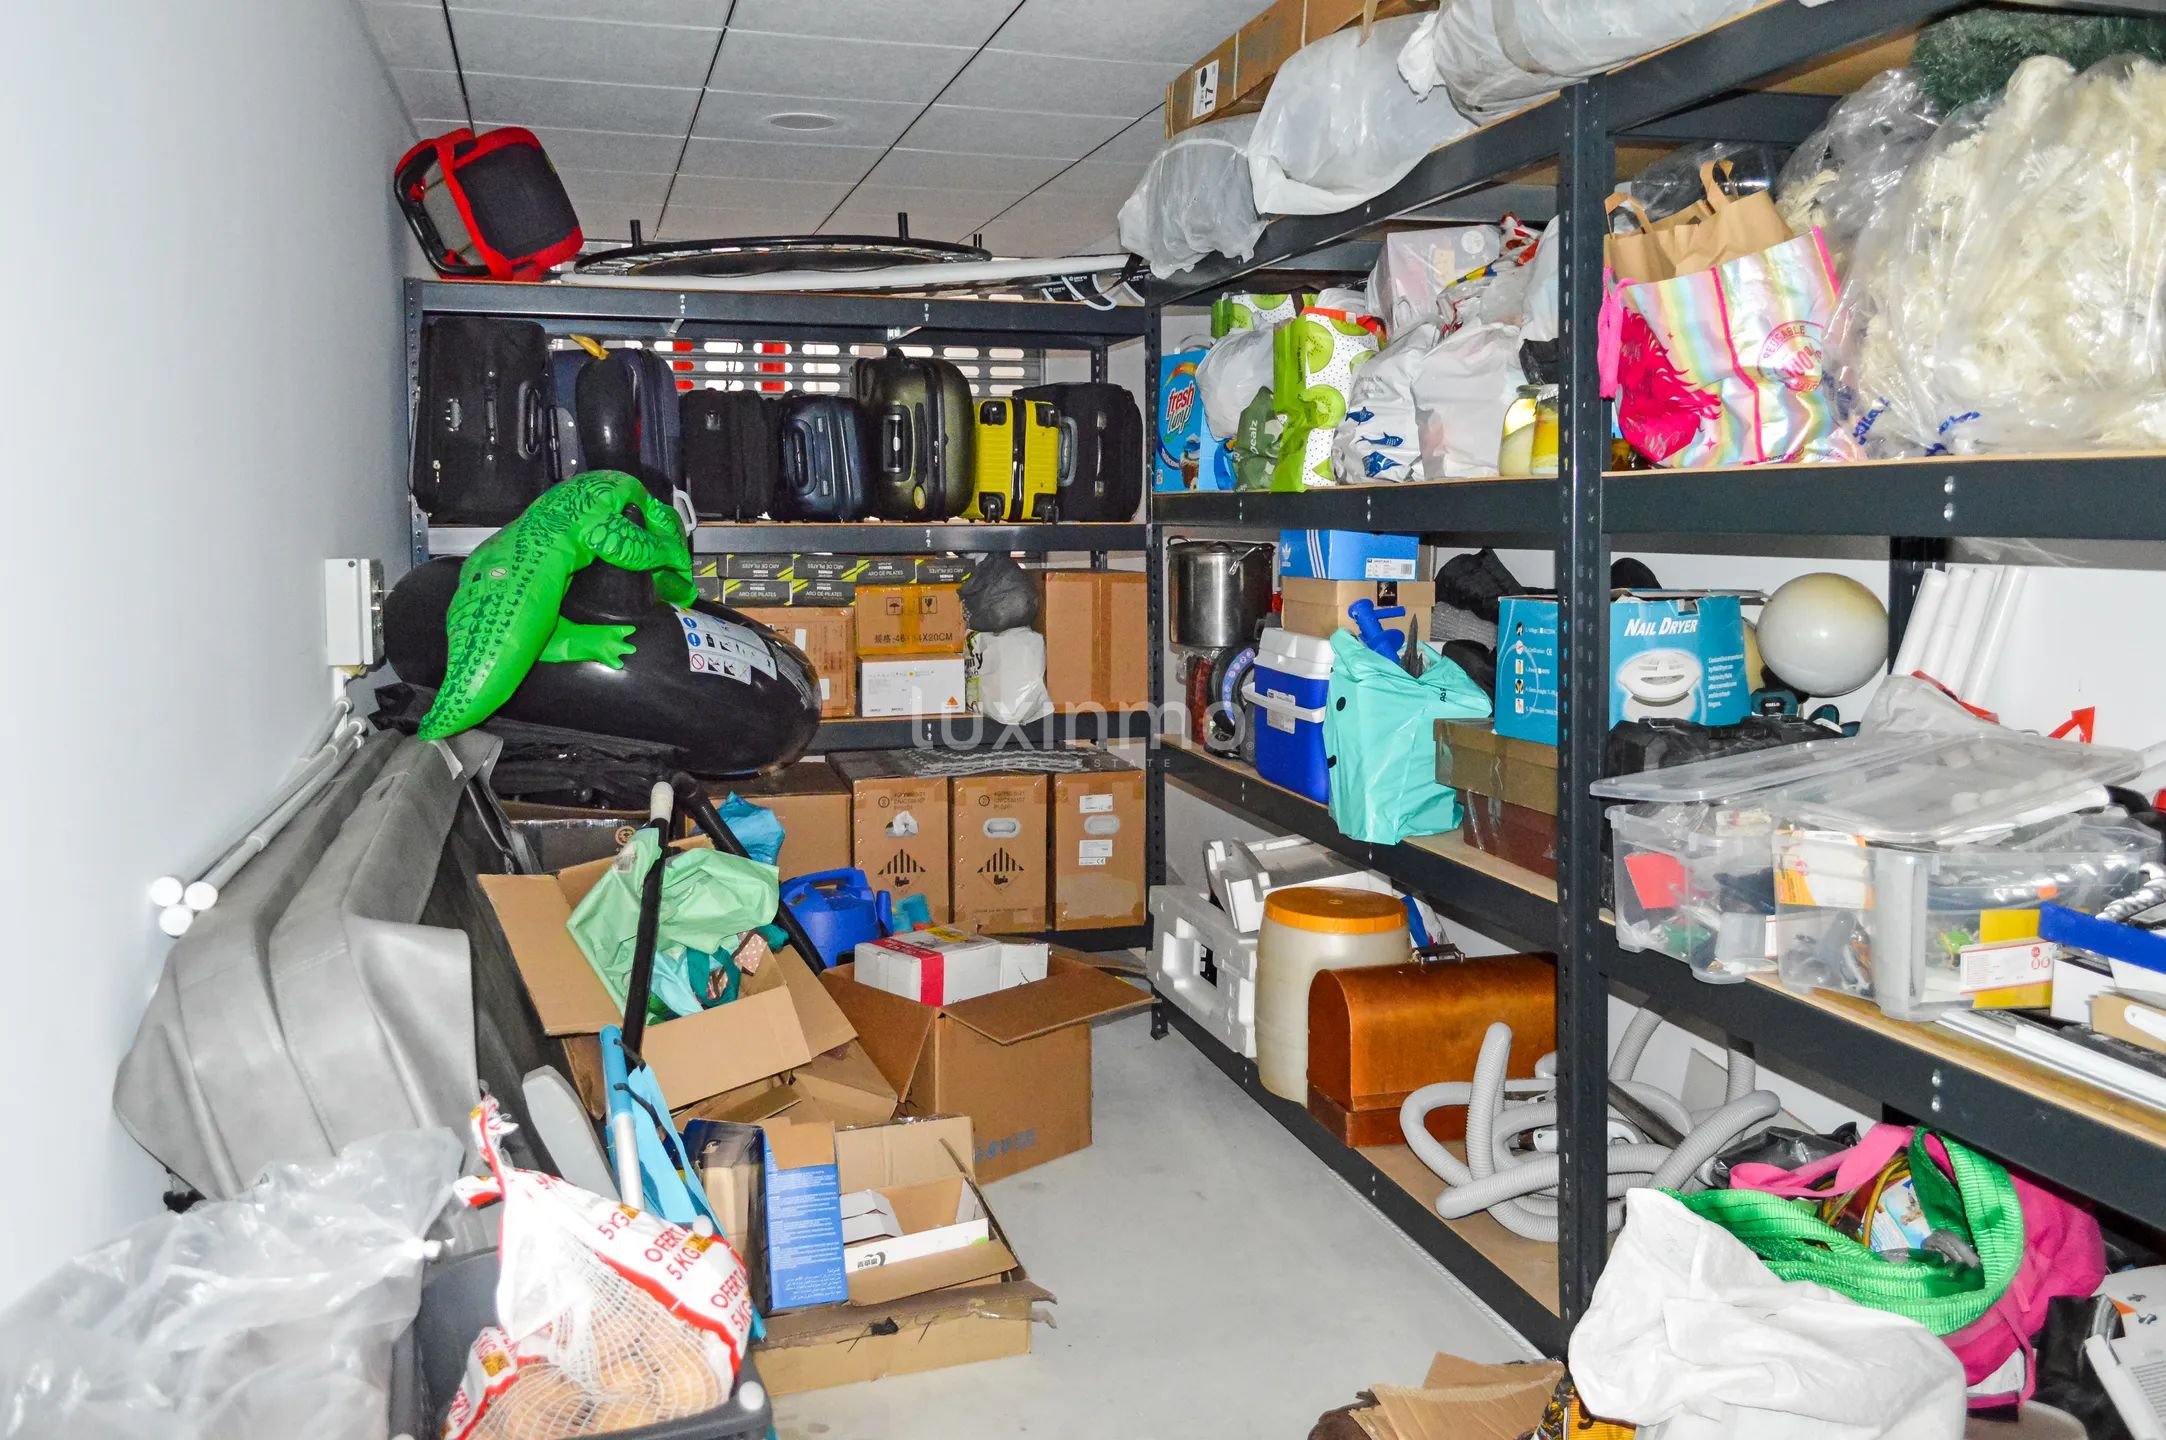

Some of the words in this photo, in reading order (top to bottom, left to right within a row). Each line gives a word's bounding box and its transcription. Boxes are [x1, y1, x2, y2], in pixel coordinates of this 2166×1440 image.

[1204, 87, 1214, 110] 17
[1763, 325, 1805, 359] REUSABLE
[1168, 382, 1195, 415] fresh
[1624, 618, 1657, 637] NAIL
[1658, 616, 1698, 636] DRYER
